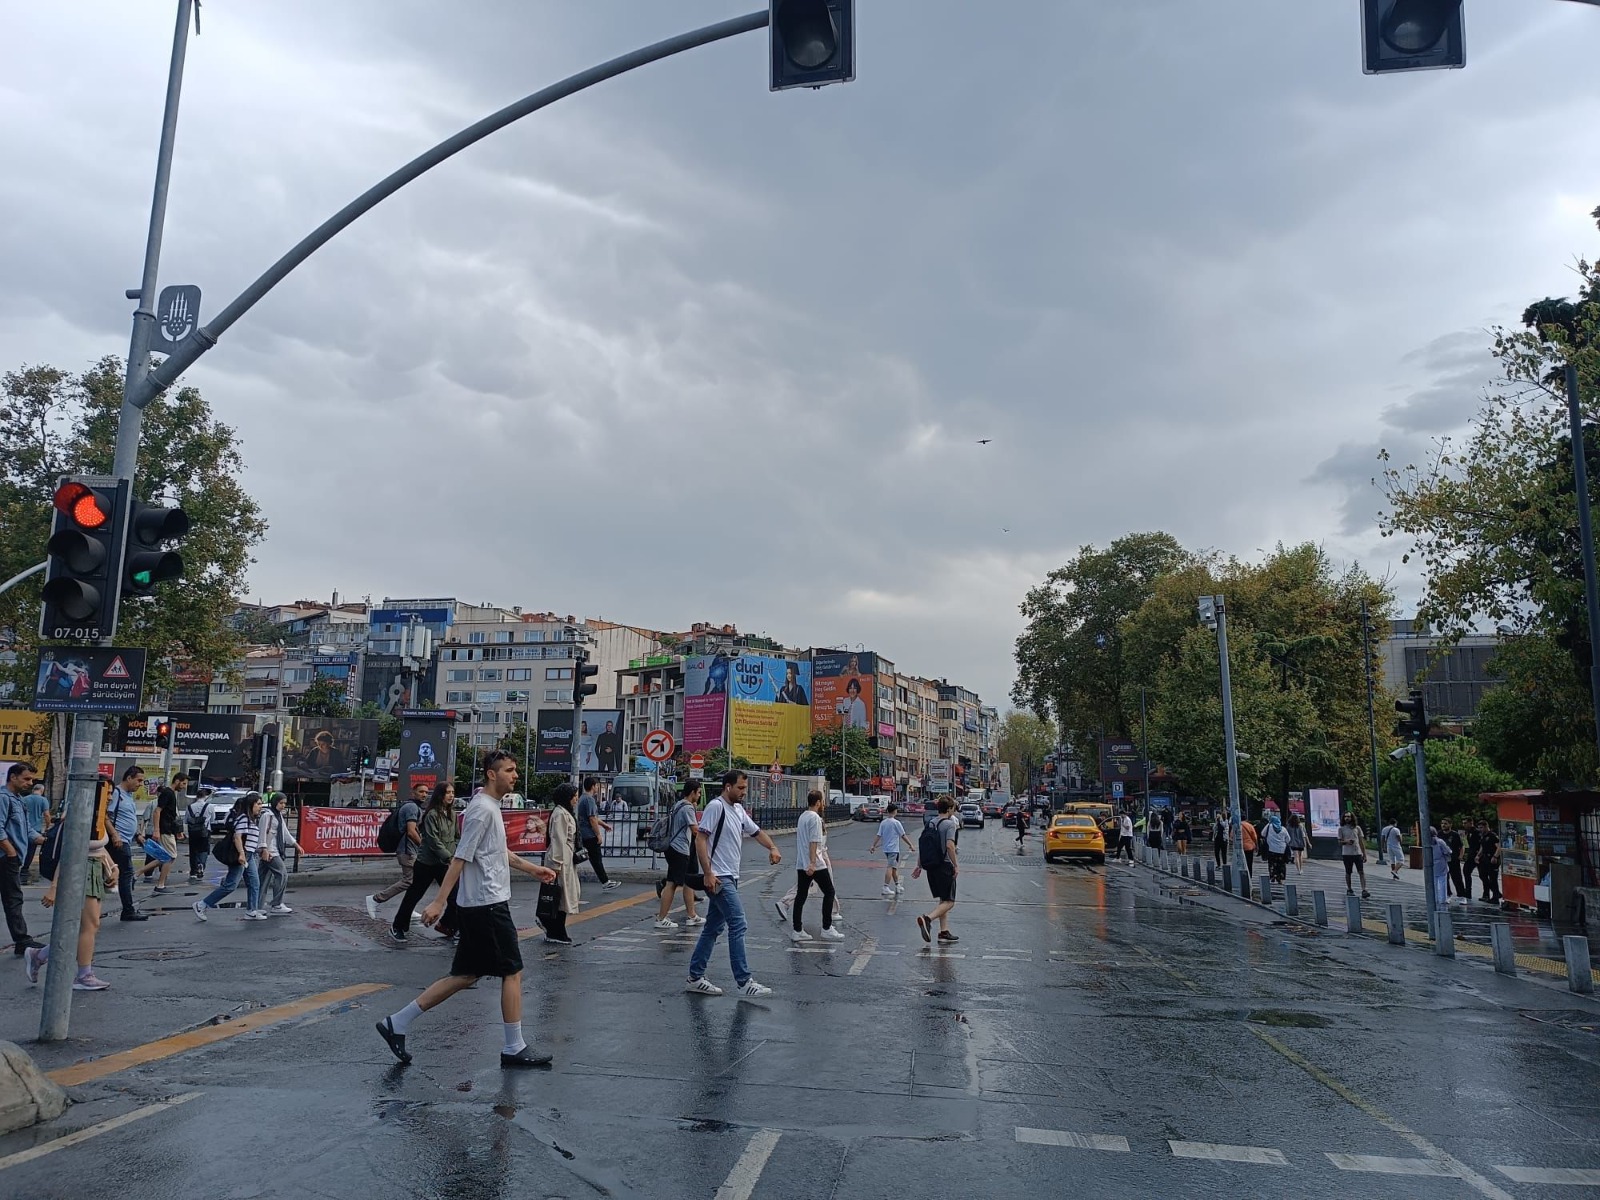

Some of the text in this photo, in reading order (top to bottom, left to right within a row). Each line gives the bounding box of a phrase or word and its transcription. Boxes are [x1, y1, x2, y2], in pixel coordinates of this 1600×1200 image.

[54, 628, 99, 639] 07-015
[736, 658, 764, 675] dual
[93, 681, 137, 691] Ben duyarlı
[741, 674, 758, 689] up
[92, 690, 135, 699] sürücüyüm
[743, 697, 773, 708] diploma
[177, 731, 230, 741] DAYANIŞMA
[316, 823, 383, 840] EMİNÖNÜ'N
